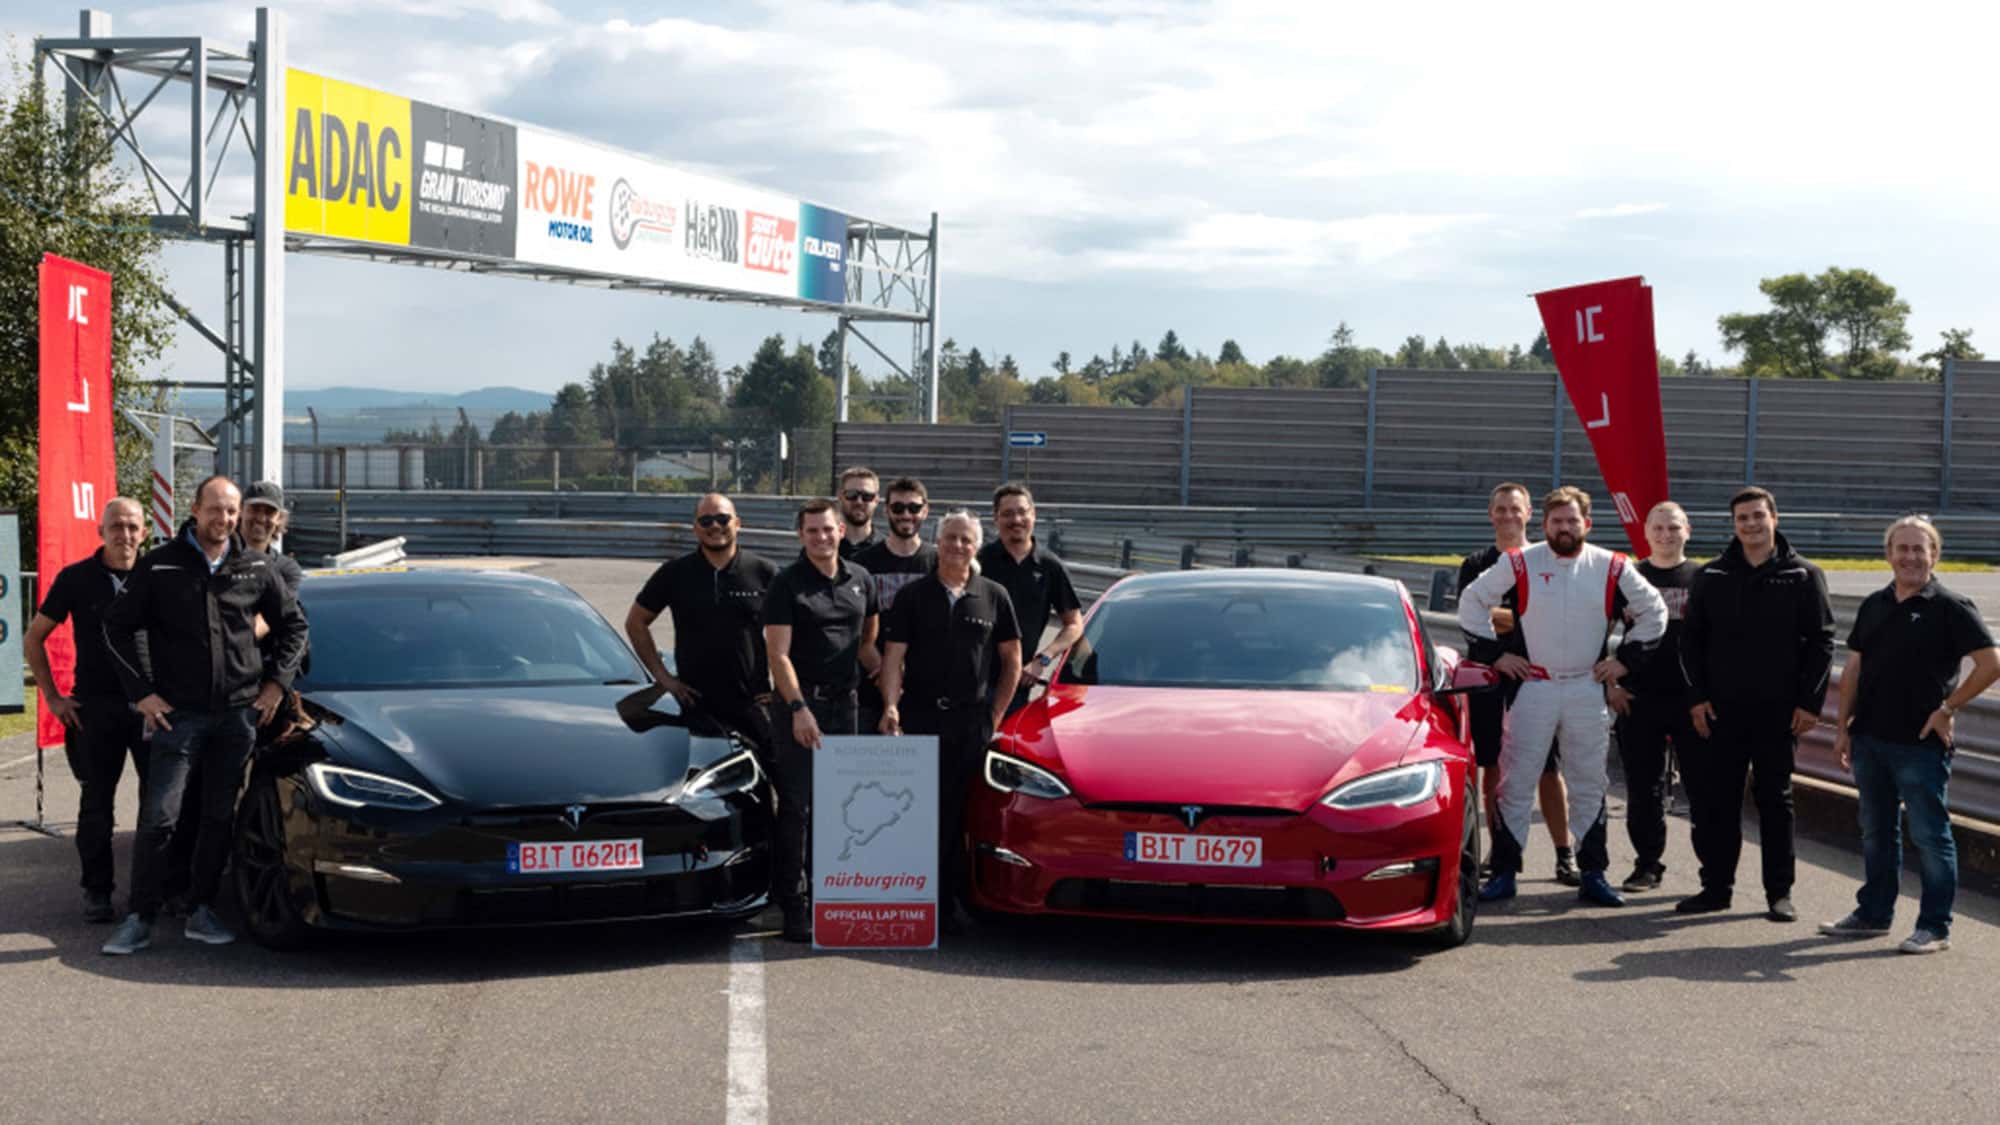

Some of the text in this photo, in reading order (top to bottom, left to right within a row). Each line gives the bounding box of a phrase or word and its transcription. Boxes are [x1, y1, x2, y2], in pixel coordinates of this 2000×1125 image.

[288, 107, 402, 212] ADAC
[420, 169, 506, 212] GRAN TURISMO
[524, 160, 595, 221] ROWE
[548, 220, 593, 244] MOTOR OIL
[685, 200, 719, 252] H&R
[521, 842, 641, 870] BIT 06201
[1141, 835, 1257, 863] BIT 0679
[824, 872, 927, 891] nürburgring
[824, 909, 926, 921] OFFICIAL LAP TIME
